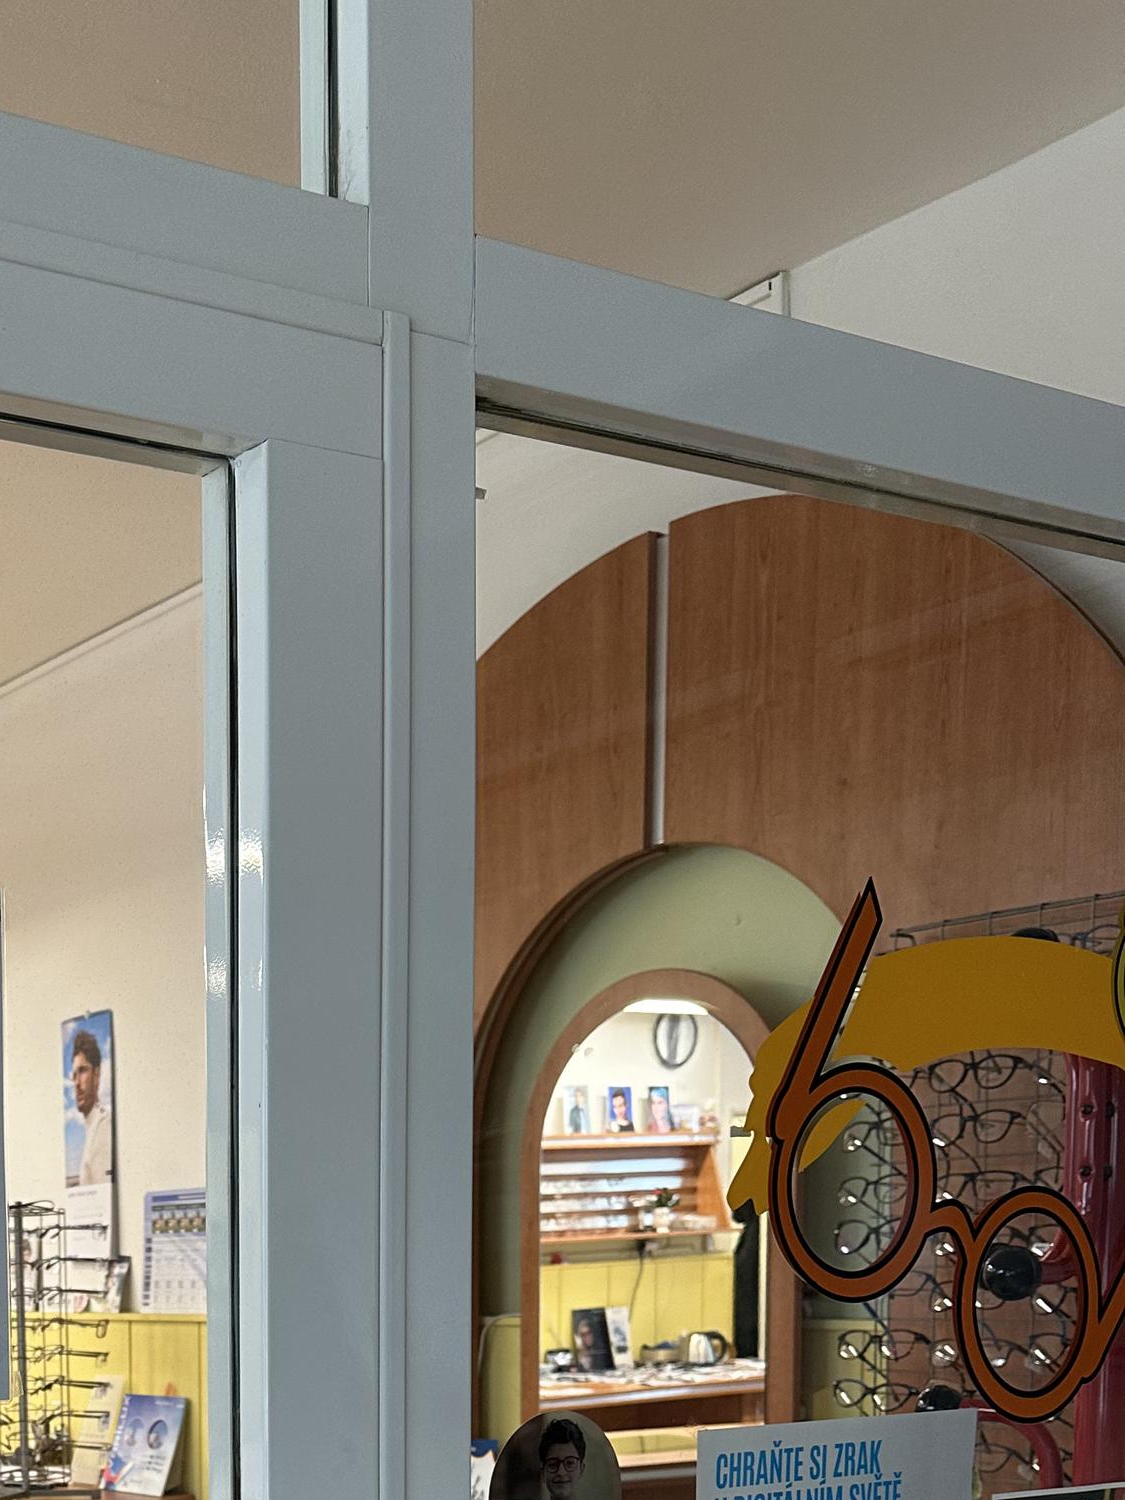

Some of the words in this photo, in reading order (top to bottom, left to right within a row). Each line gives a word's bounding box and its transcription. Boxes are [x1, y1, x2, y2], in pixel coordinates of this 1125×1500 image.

[715, 1440, 805, 1490] CHRAŇTE
[809, 1444, 828, 1481] SI
[832, 1439, 883, 1479] ZRAK
